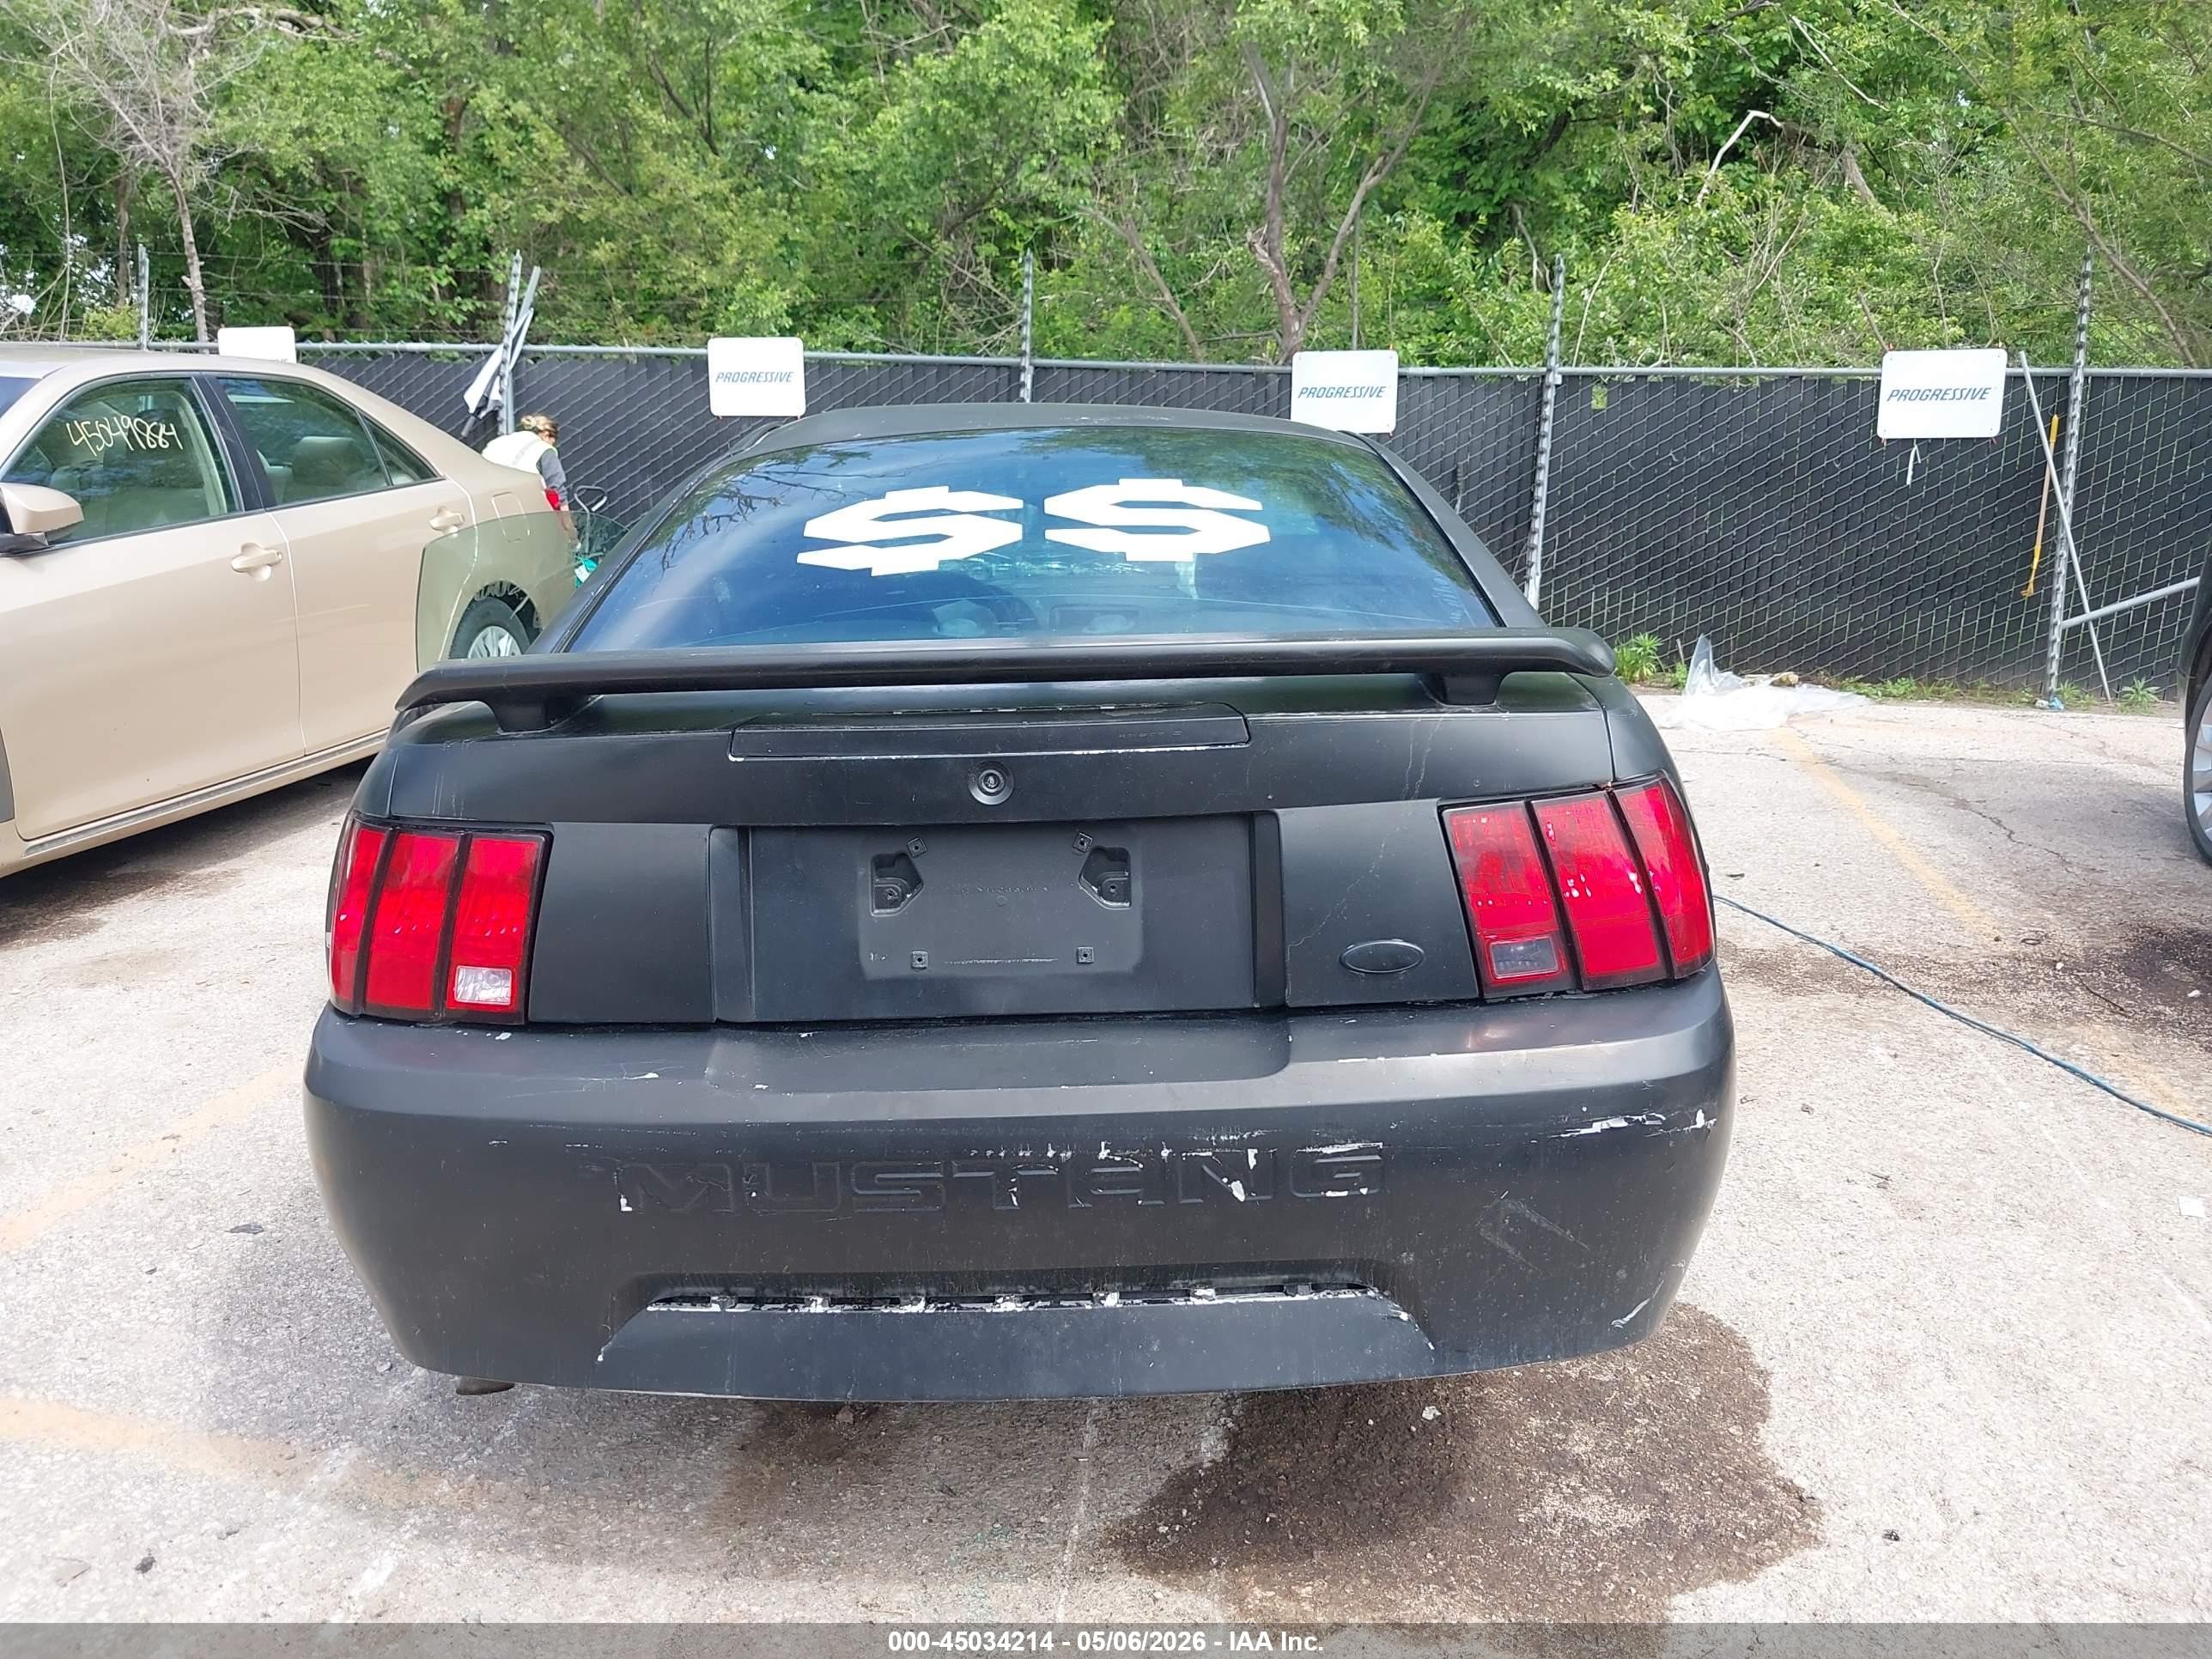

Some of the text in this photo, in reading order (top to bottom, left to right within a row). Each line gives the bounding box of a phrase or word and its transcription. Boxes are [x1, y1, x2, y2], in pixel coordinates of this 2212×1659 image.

[715, 371, 794, 383] PROGRESSIVE
[1297, 386, 1387, 398] PROGRESSIVE
[1887, 387, 1991, 402] PROGRESSIVE
[65, 415, 184, 457] 45049884
[613, 1146, 1384, 1213] MUSTANG
